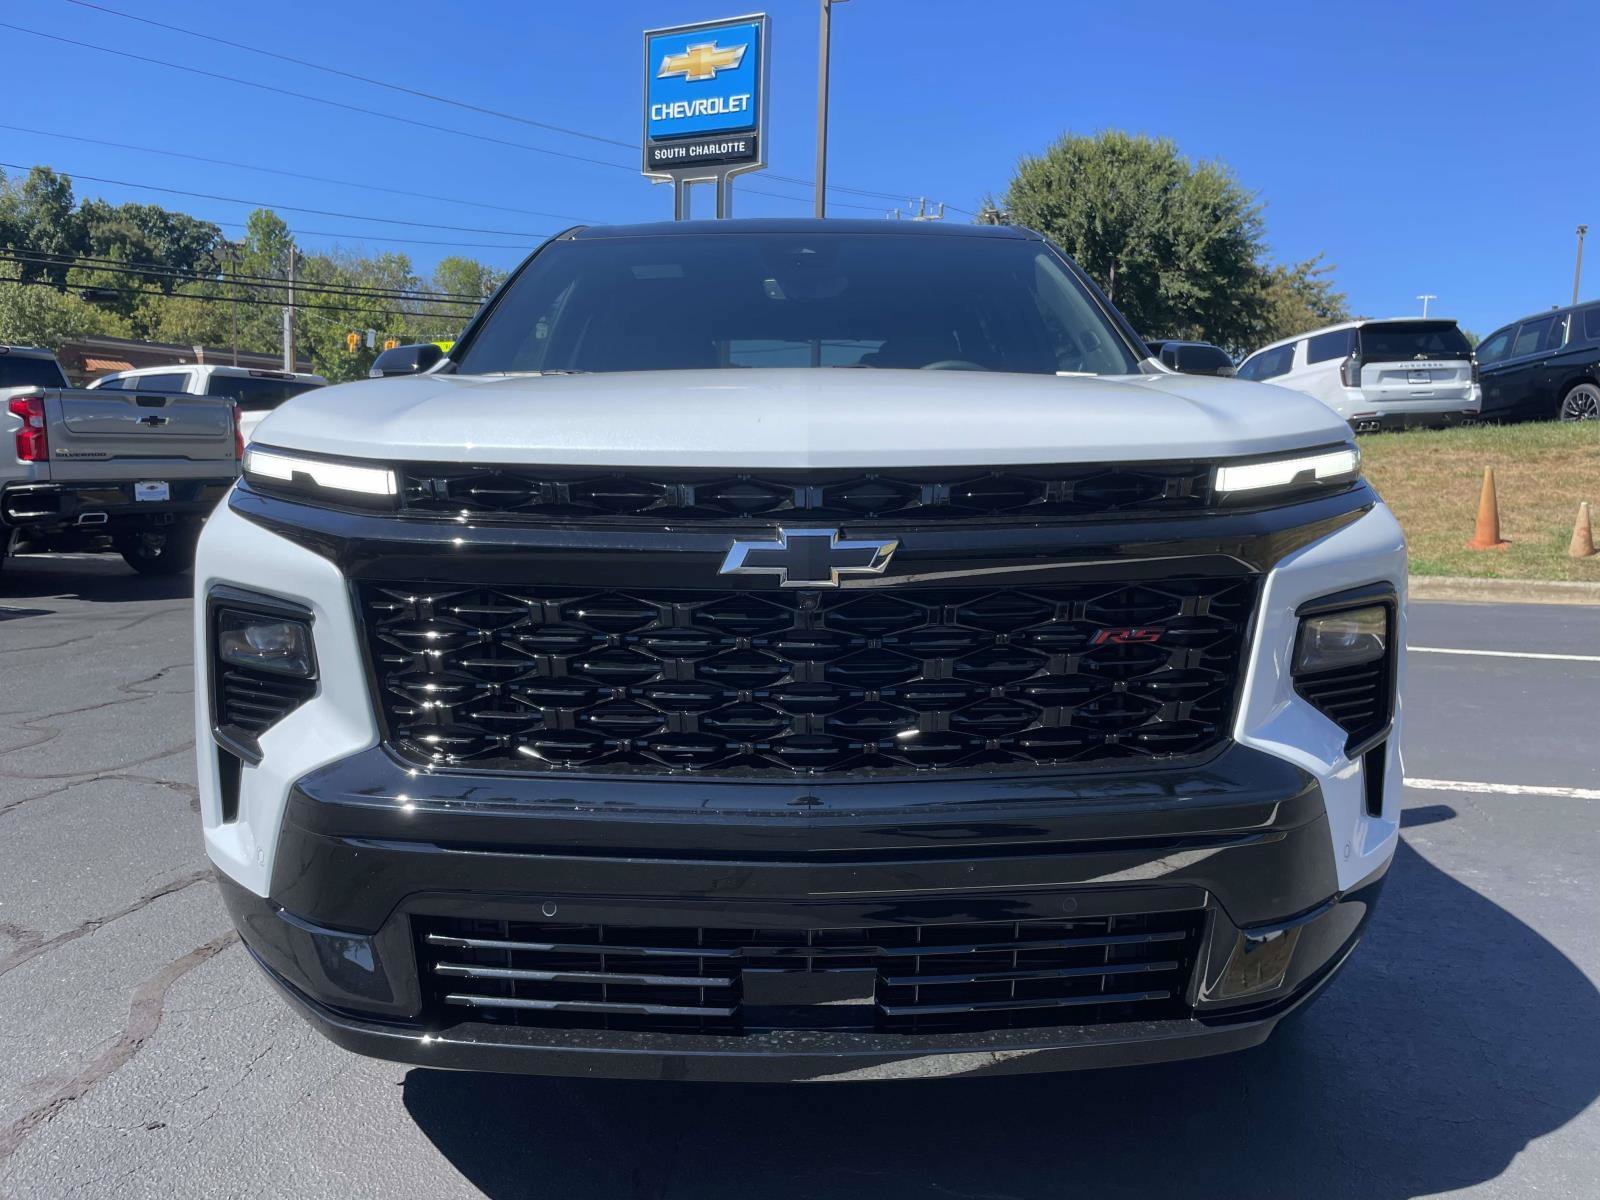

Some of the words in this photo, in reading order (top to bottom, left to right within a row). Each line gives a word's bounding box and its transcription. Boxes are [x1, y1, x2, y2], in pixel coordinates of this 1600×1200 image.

[651, 94, 750, 121] CHEVROLET
[654, 147, 686, 160] SOUTH
[689, 142, 746, 156] CHARLOTTE
[1090, 628, 1165, 645] RS
